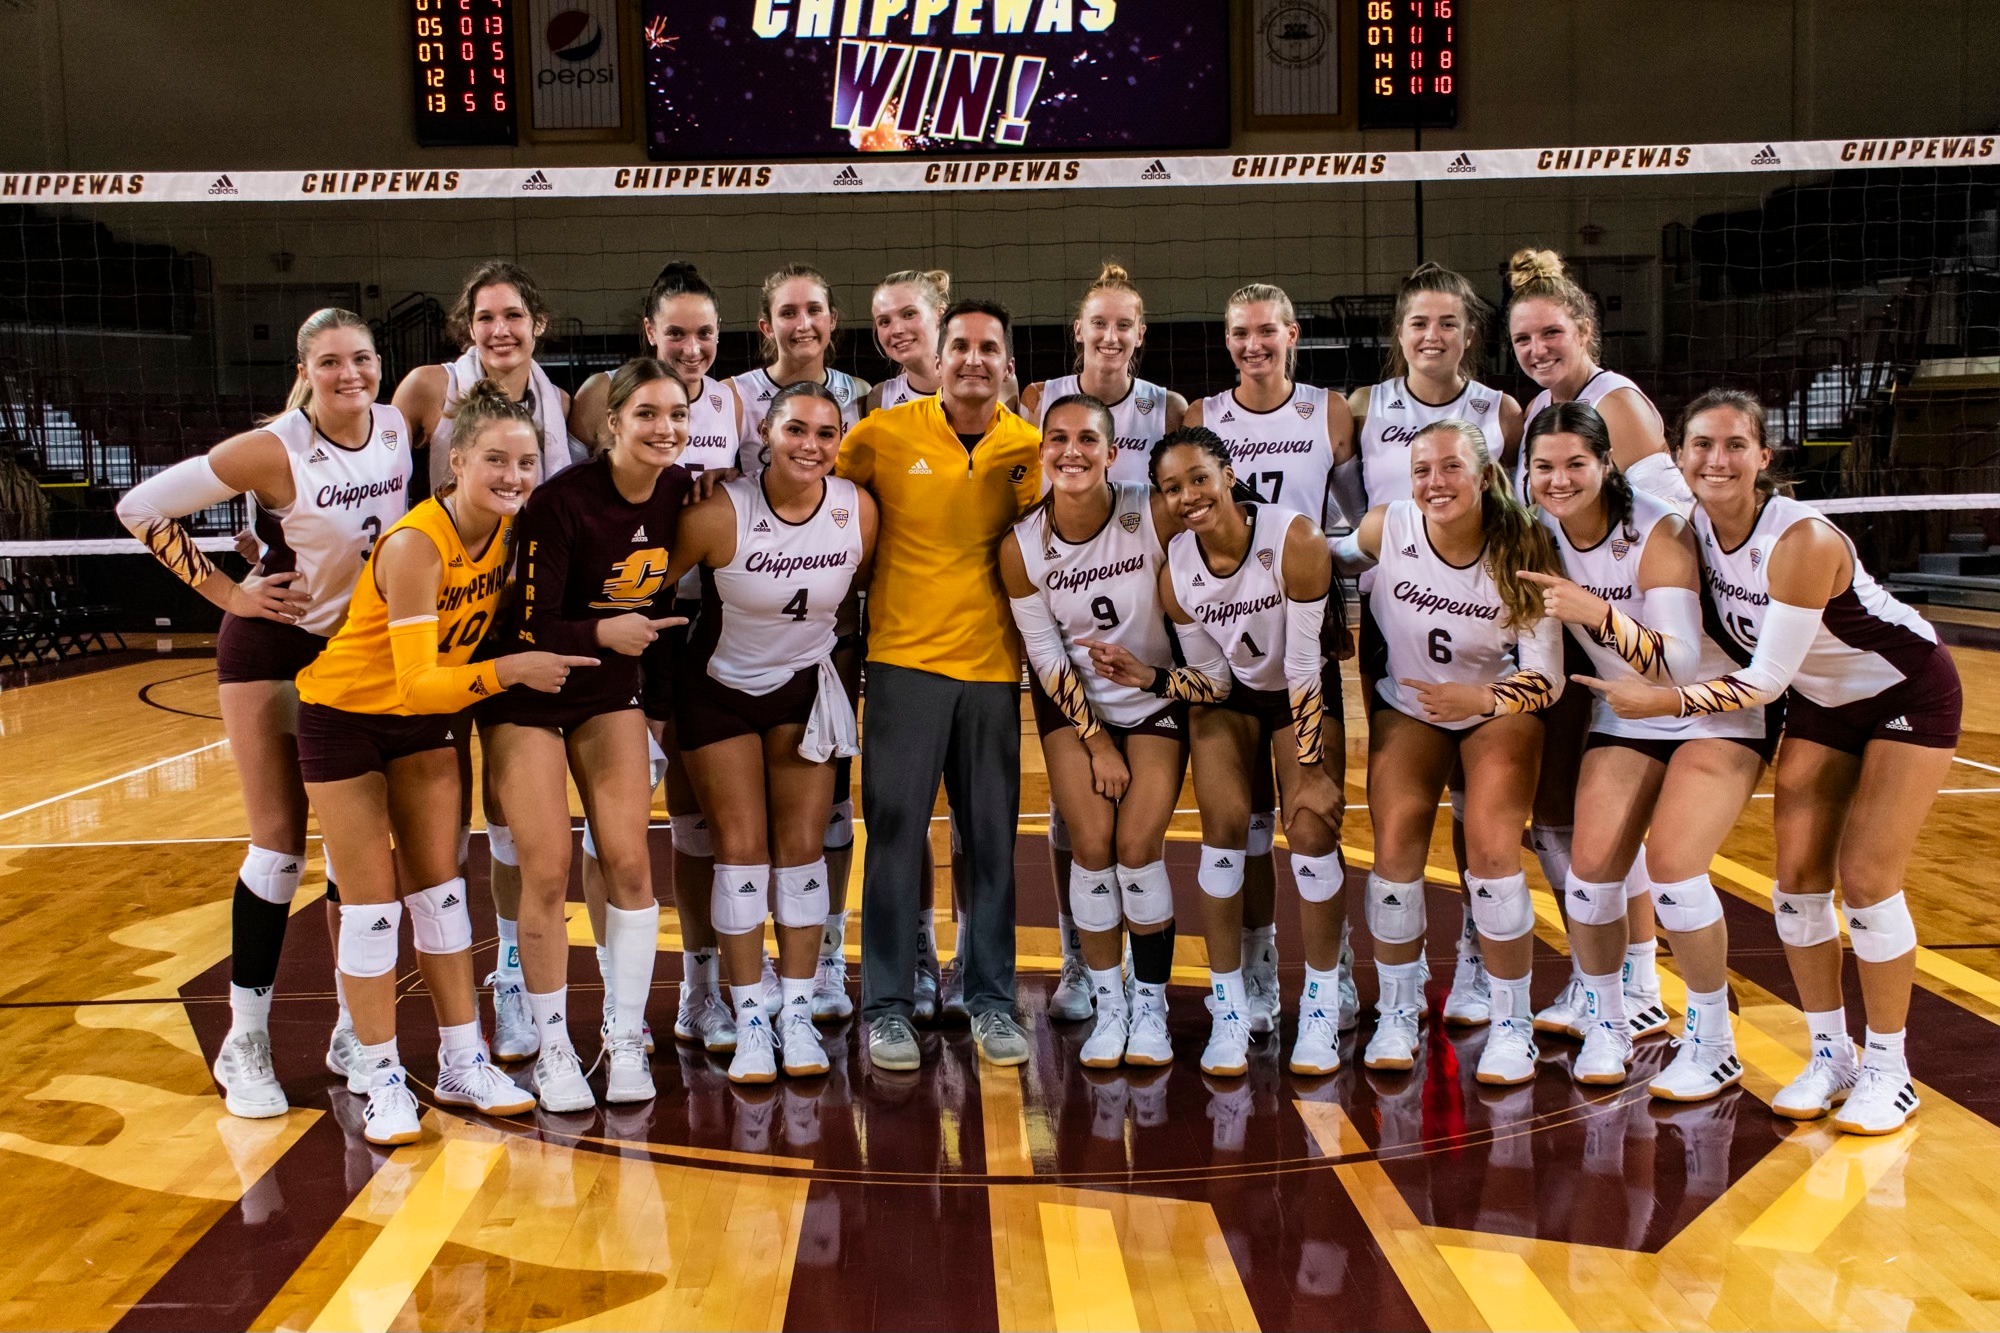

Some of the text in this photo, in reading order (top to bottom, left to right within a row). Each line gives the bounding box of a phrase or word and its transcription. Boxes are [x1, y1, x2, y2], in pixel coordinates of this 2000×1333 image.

[751, 0, 1117, 39] CHIPPEWAS
[1368, 1, 1393, 20] 06
[1434, 0, 1452, 19] 16
[417, 16, 503, 36] 05 0 13
[1368, 26, 1393, 46] 07
[418, 42, 504, 62] 07 0 5
[1374, 53, 1393, 70] 14
[1440, 51, 1452, 69] 8
[426, 68, 445, 87] 12
[493, 68, 505, 85] 4
[537, 64, 614, 90] pepsi
[1374, 77, 1393, 96] 15
[1434, 76, 1452, 94] 10
[427, 93, 506, 112] 13 5 6
[830, 39, 1047, 146] WIN!
[1, 137, 1996, 196] HIPPEWAS adidas CHIPPEWAS adidas CHIPPEWAS adidas CHIPPEWAS adidas CHIPPEWAS adidas CHIPPEWAS adidas CHIPPEWAS
[907, 467, 933, 475] adidas
[316, 474, 403, 511] Chippewas
[361, 515, 382, 562] 3
[745, 550, 848, 579] Chippewas
[1046, 553, 1144, 593] Chippewas
[781, 588, 809, 622] 4
[1090, 595, 1121, 631] 9
[1194, 590, 1282, 627] Chippewas
[1393, 580, 1501, 621] Chippewas
[437, 610, 489, 654] 10
[1726, 611, 1758, 648] 15
[1240, 631, 1266, 658] 1
[1428, 627, 1452, 665] 6
[1154, 722, 1179, 730] adidas
[1885, 722, 1913, 732] adidas
